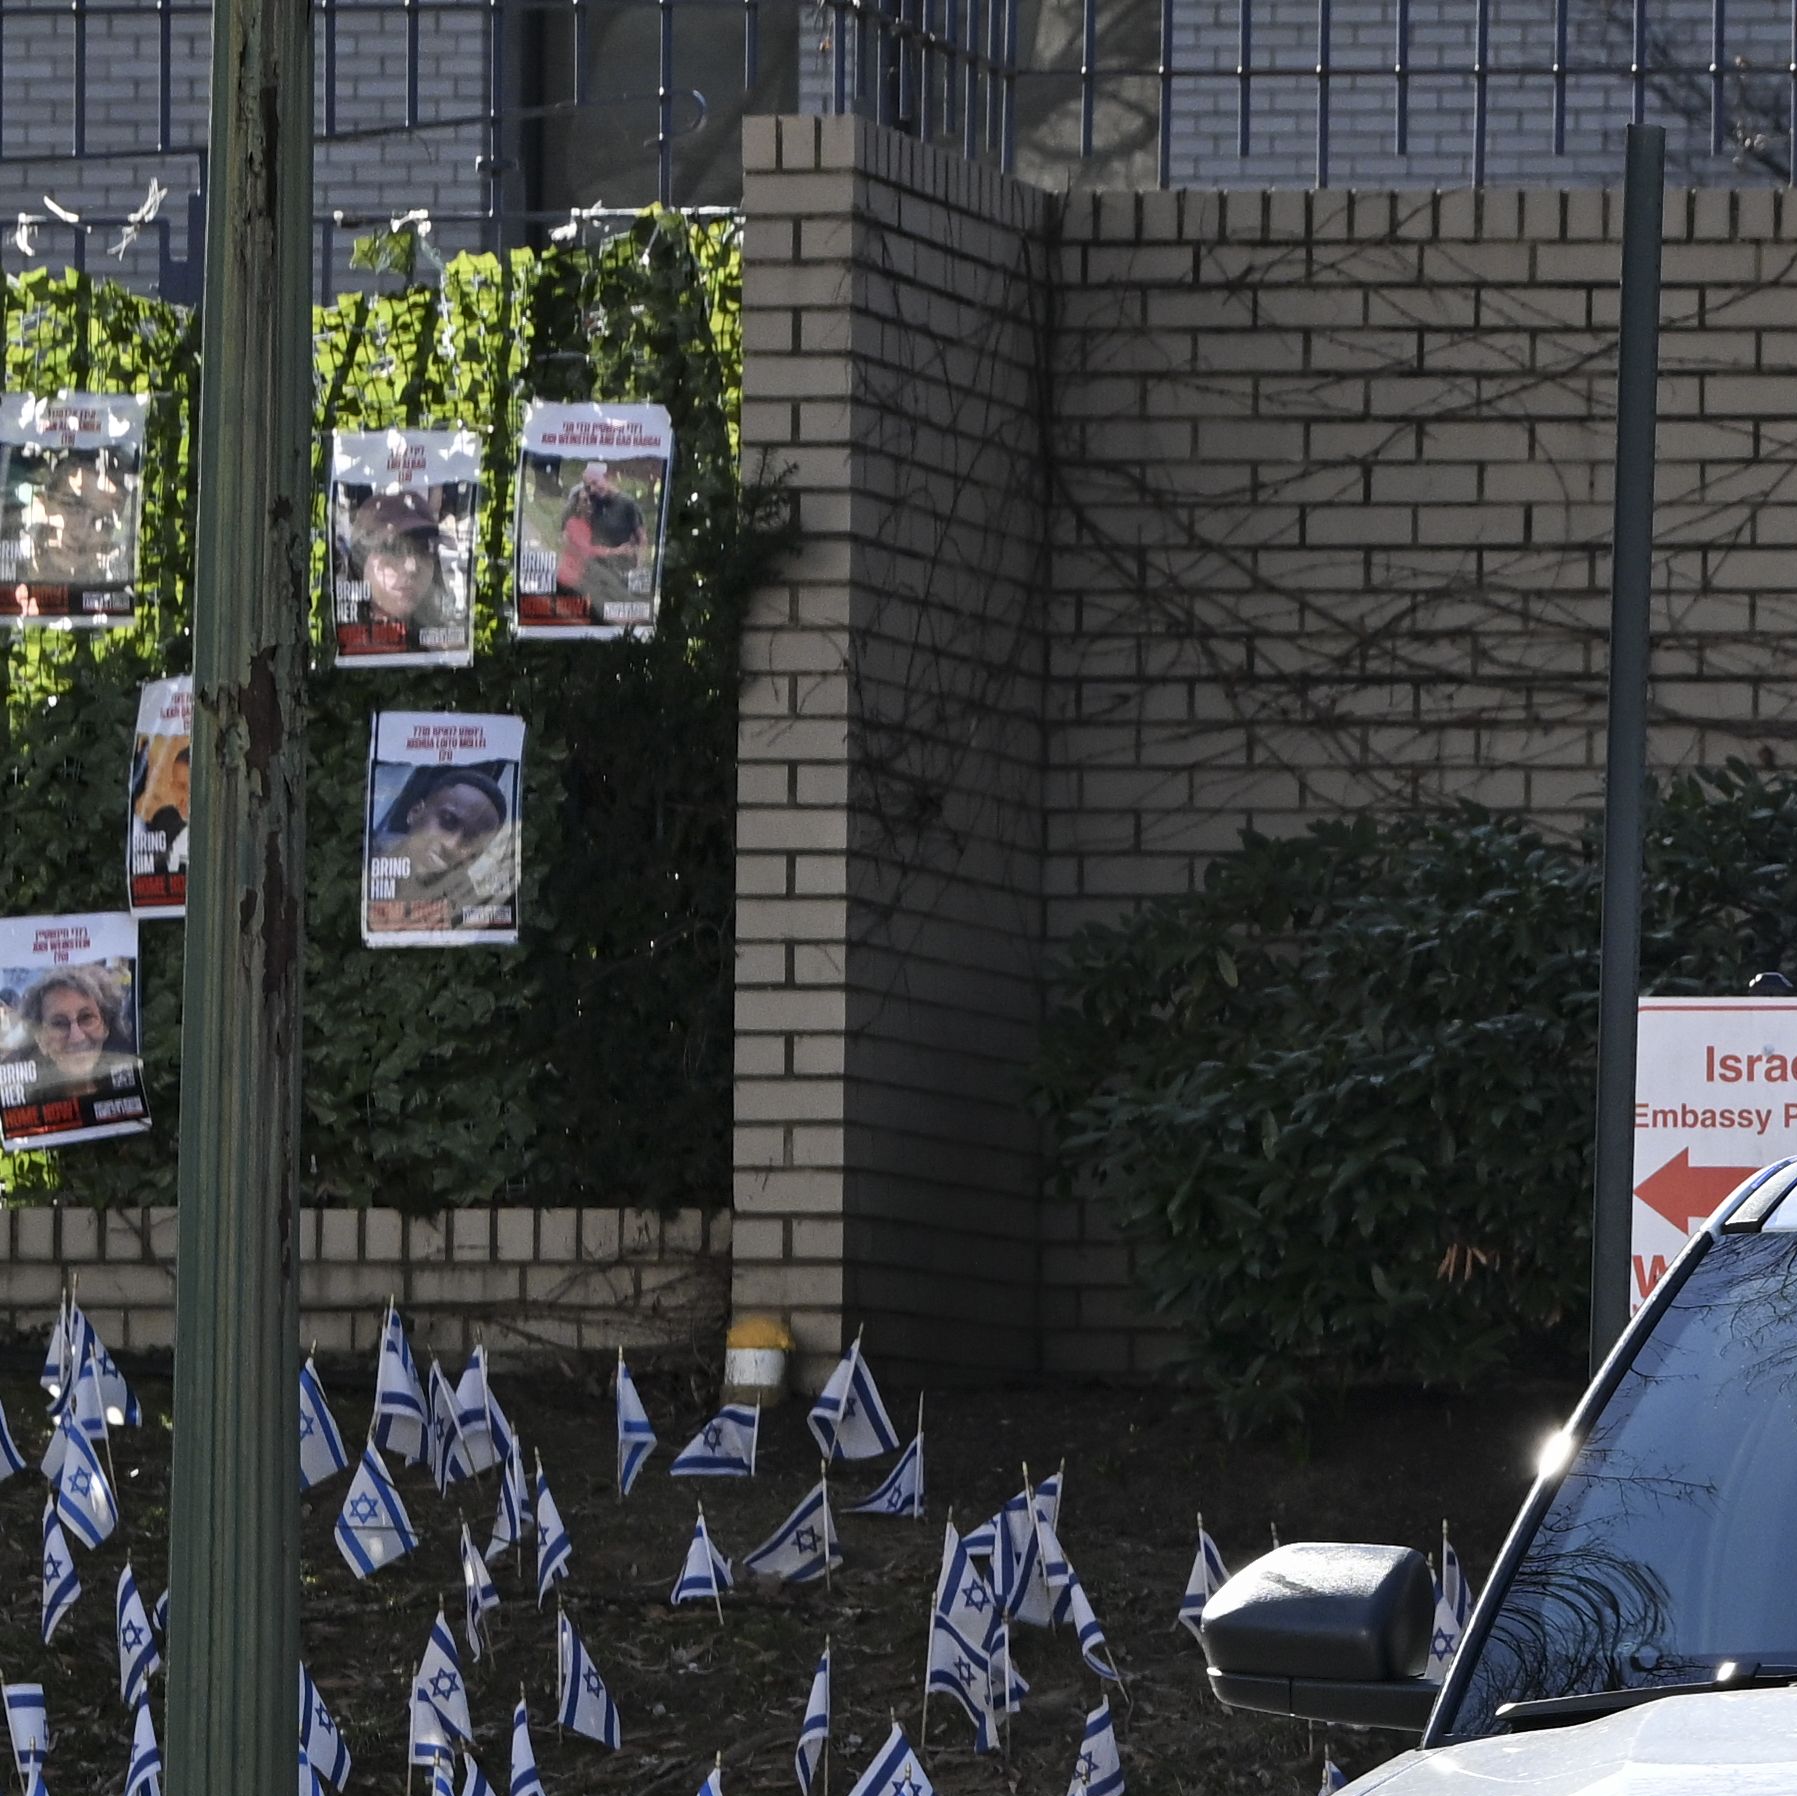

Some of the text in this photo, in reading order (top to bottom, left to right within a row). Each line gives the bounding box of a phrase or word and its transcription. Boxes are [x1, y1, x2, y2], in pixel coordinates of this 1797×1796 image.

[371, 857, 411, 880] BRING
[370, 877, 396, 899] HIM
[0, 1060, 37, 1085] BRING
[1, 1083, 26, 1107] HER
[1634, 1102, 1773, 1136] Embassy
